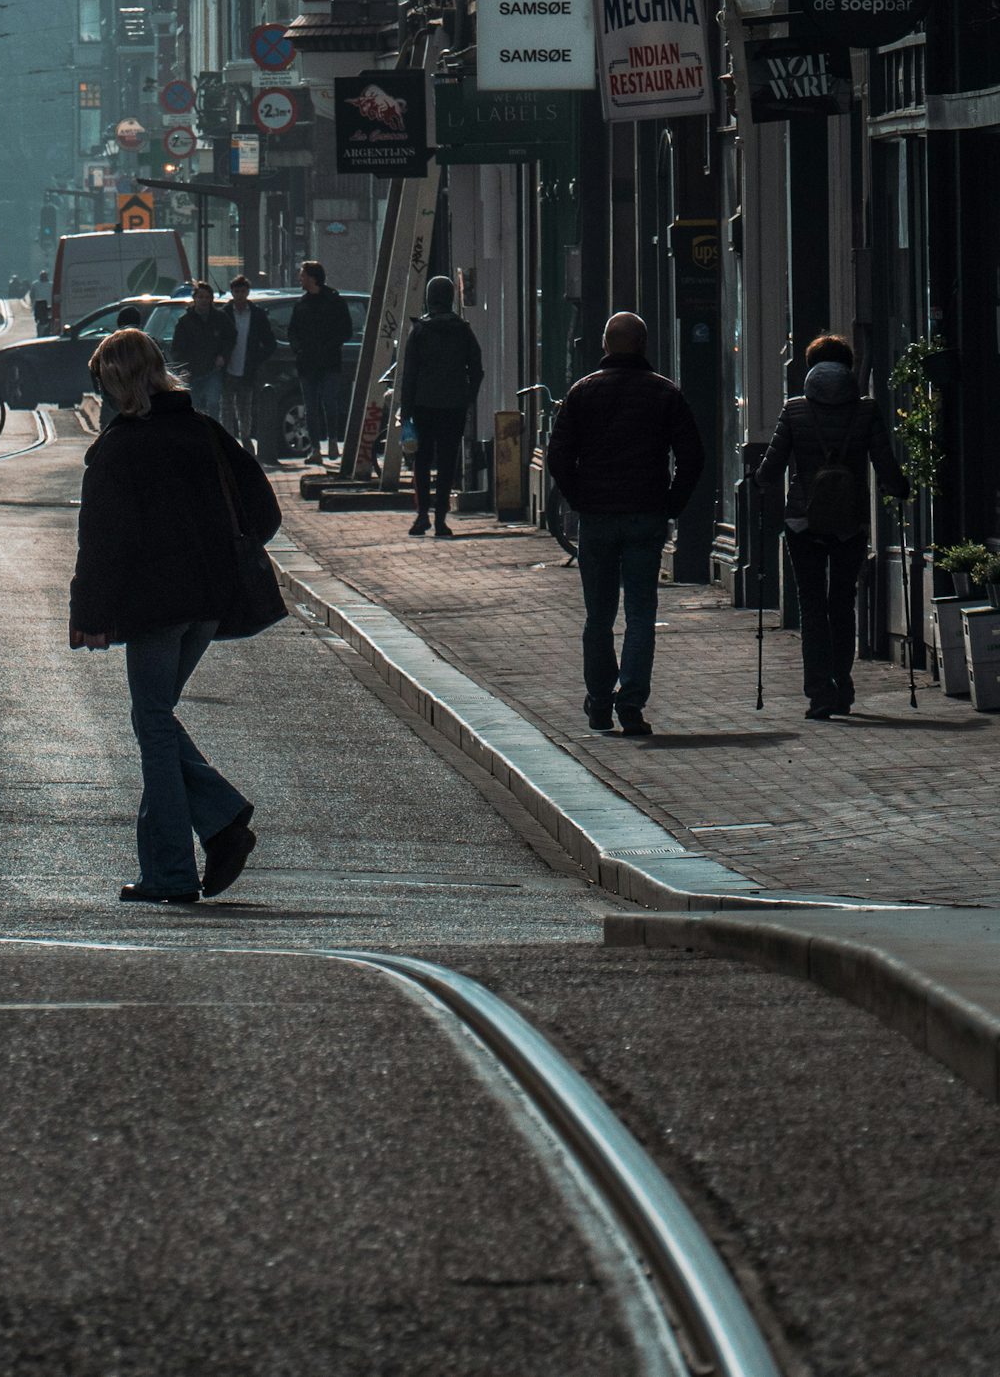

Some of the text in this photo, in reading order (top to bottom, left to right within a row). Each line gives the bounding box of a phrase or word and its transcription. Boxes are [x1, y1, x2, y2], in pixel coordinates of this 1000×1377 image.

[499, 1, 572, 15] SAMSØE
[499, 49, 572, 63] SAMSØE
[629, 42, 681, 68] INDIAN
[609, 65, 704, 97] RESTAURANT
[477, 104, 558, 122] LABELS
[343, 146, 416, 158] ARGENTIJNS
[351, 157, 408, 165] restaurant
[129, 215, 144, 229] P
